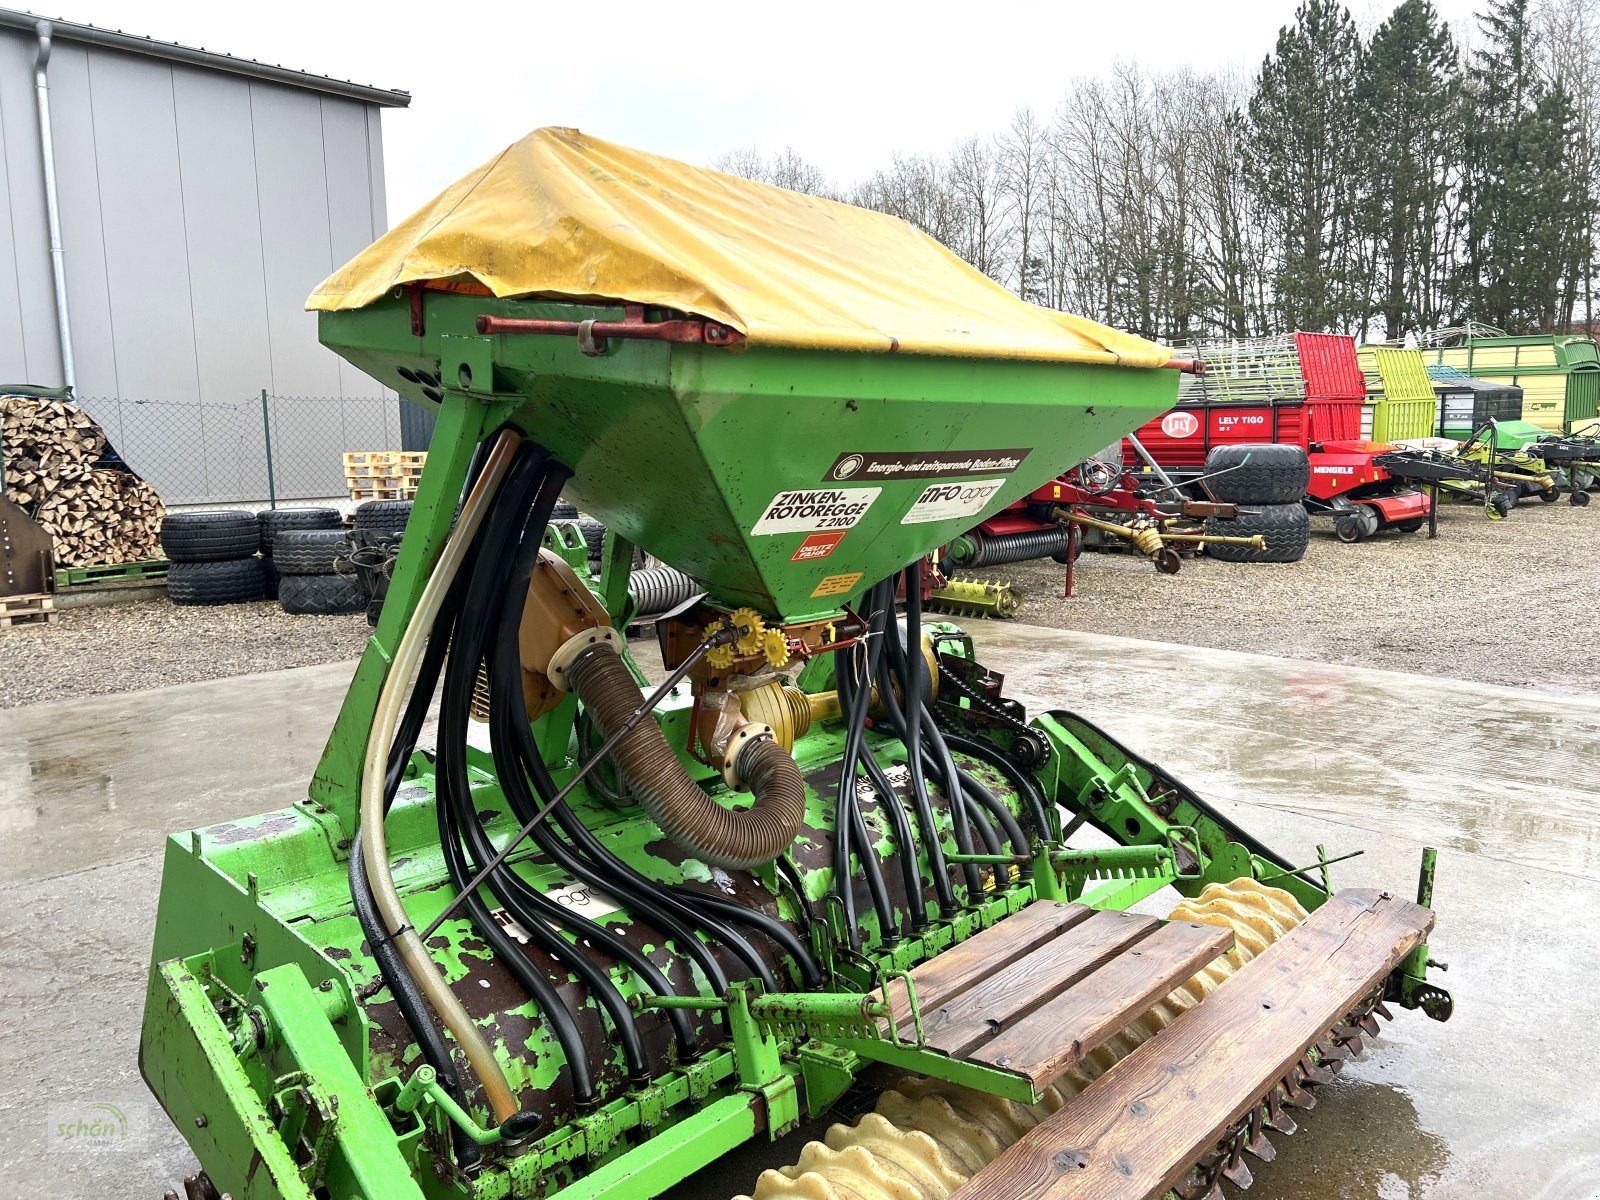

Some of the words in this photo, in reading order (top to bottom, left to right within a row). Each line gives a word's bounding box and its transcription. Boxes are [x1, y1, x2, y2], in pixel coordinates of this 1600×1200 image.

[1242, 416, 1264, 424] TIGO
[921, 458, 971, 473] zeitsparende
[971, 457, 1021, 469] Boden-Pflege
[1313, 466, 1354, 474] MENGELE
[775, 491, 847, 506] ZINKEN-
[960, 485, 999, 504] agrar
[765, 502, 868, 520] ROTOREGGE
[815, 519, 828, 528] Z
[826, 516, 856, 527] 2100
[799, 550, 827, 558] FAHR
[800, 543, 835, 553] DEUTZ
